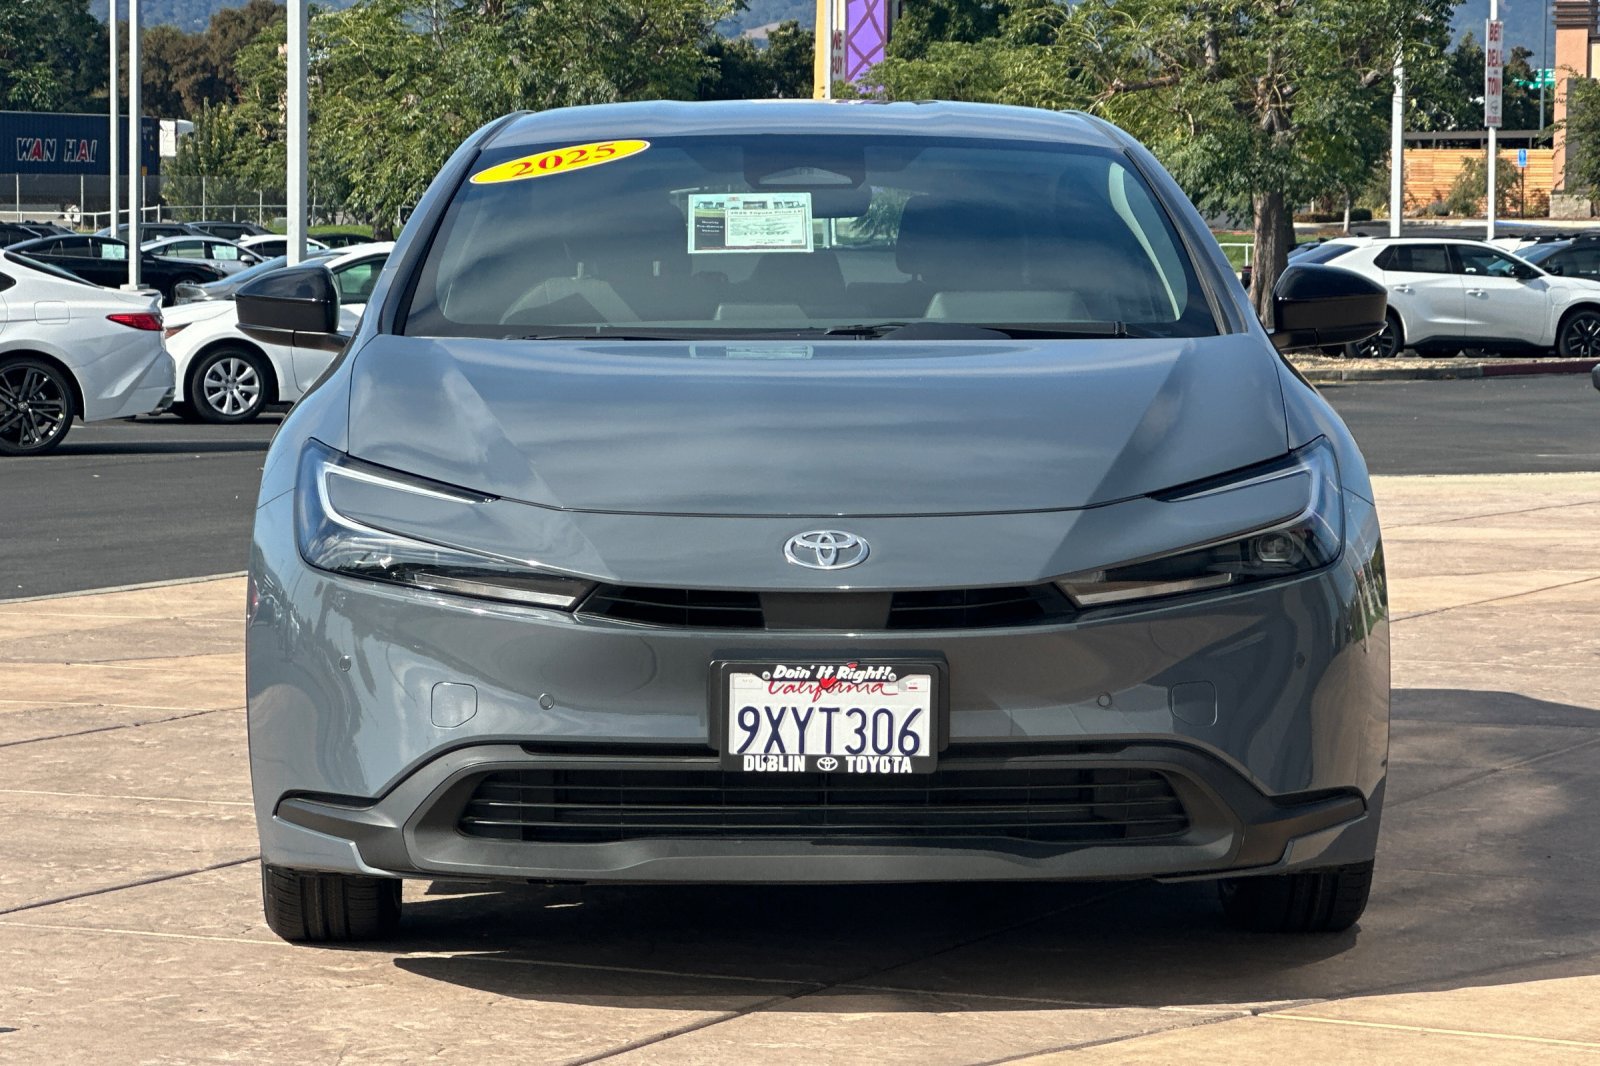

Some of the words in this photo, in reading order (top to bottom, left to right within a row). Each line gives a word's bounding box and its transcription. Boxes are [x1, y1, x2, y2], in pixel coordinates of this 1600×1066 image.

[16, 137, 57, 162] WAN
[63, 138, 98, 163] HAI
[510, 143, 617, 178] 2025
[772, 664, 815, 679] Doin'
[815, 665, 835, 680] It
[836, 665, 892, 684] Right!
[737, 706, 922, 756] 9XYT306
[743, 755, 805, 772] DUBLIN
[845, 756, 913, 773] TOYOTA
